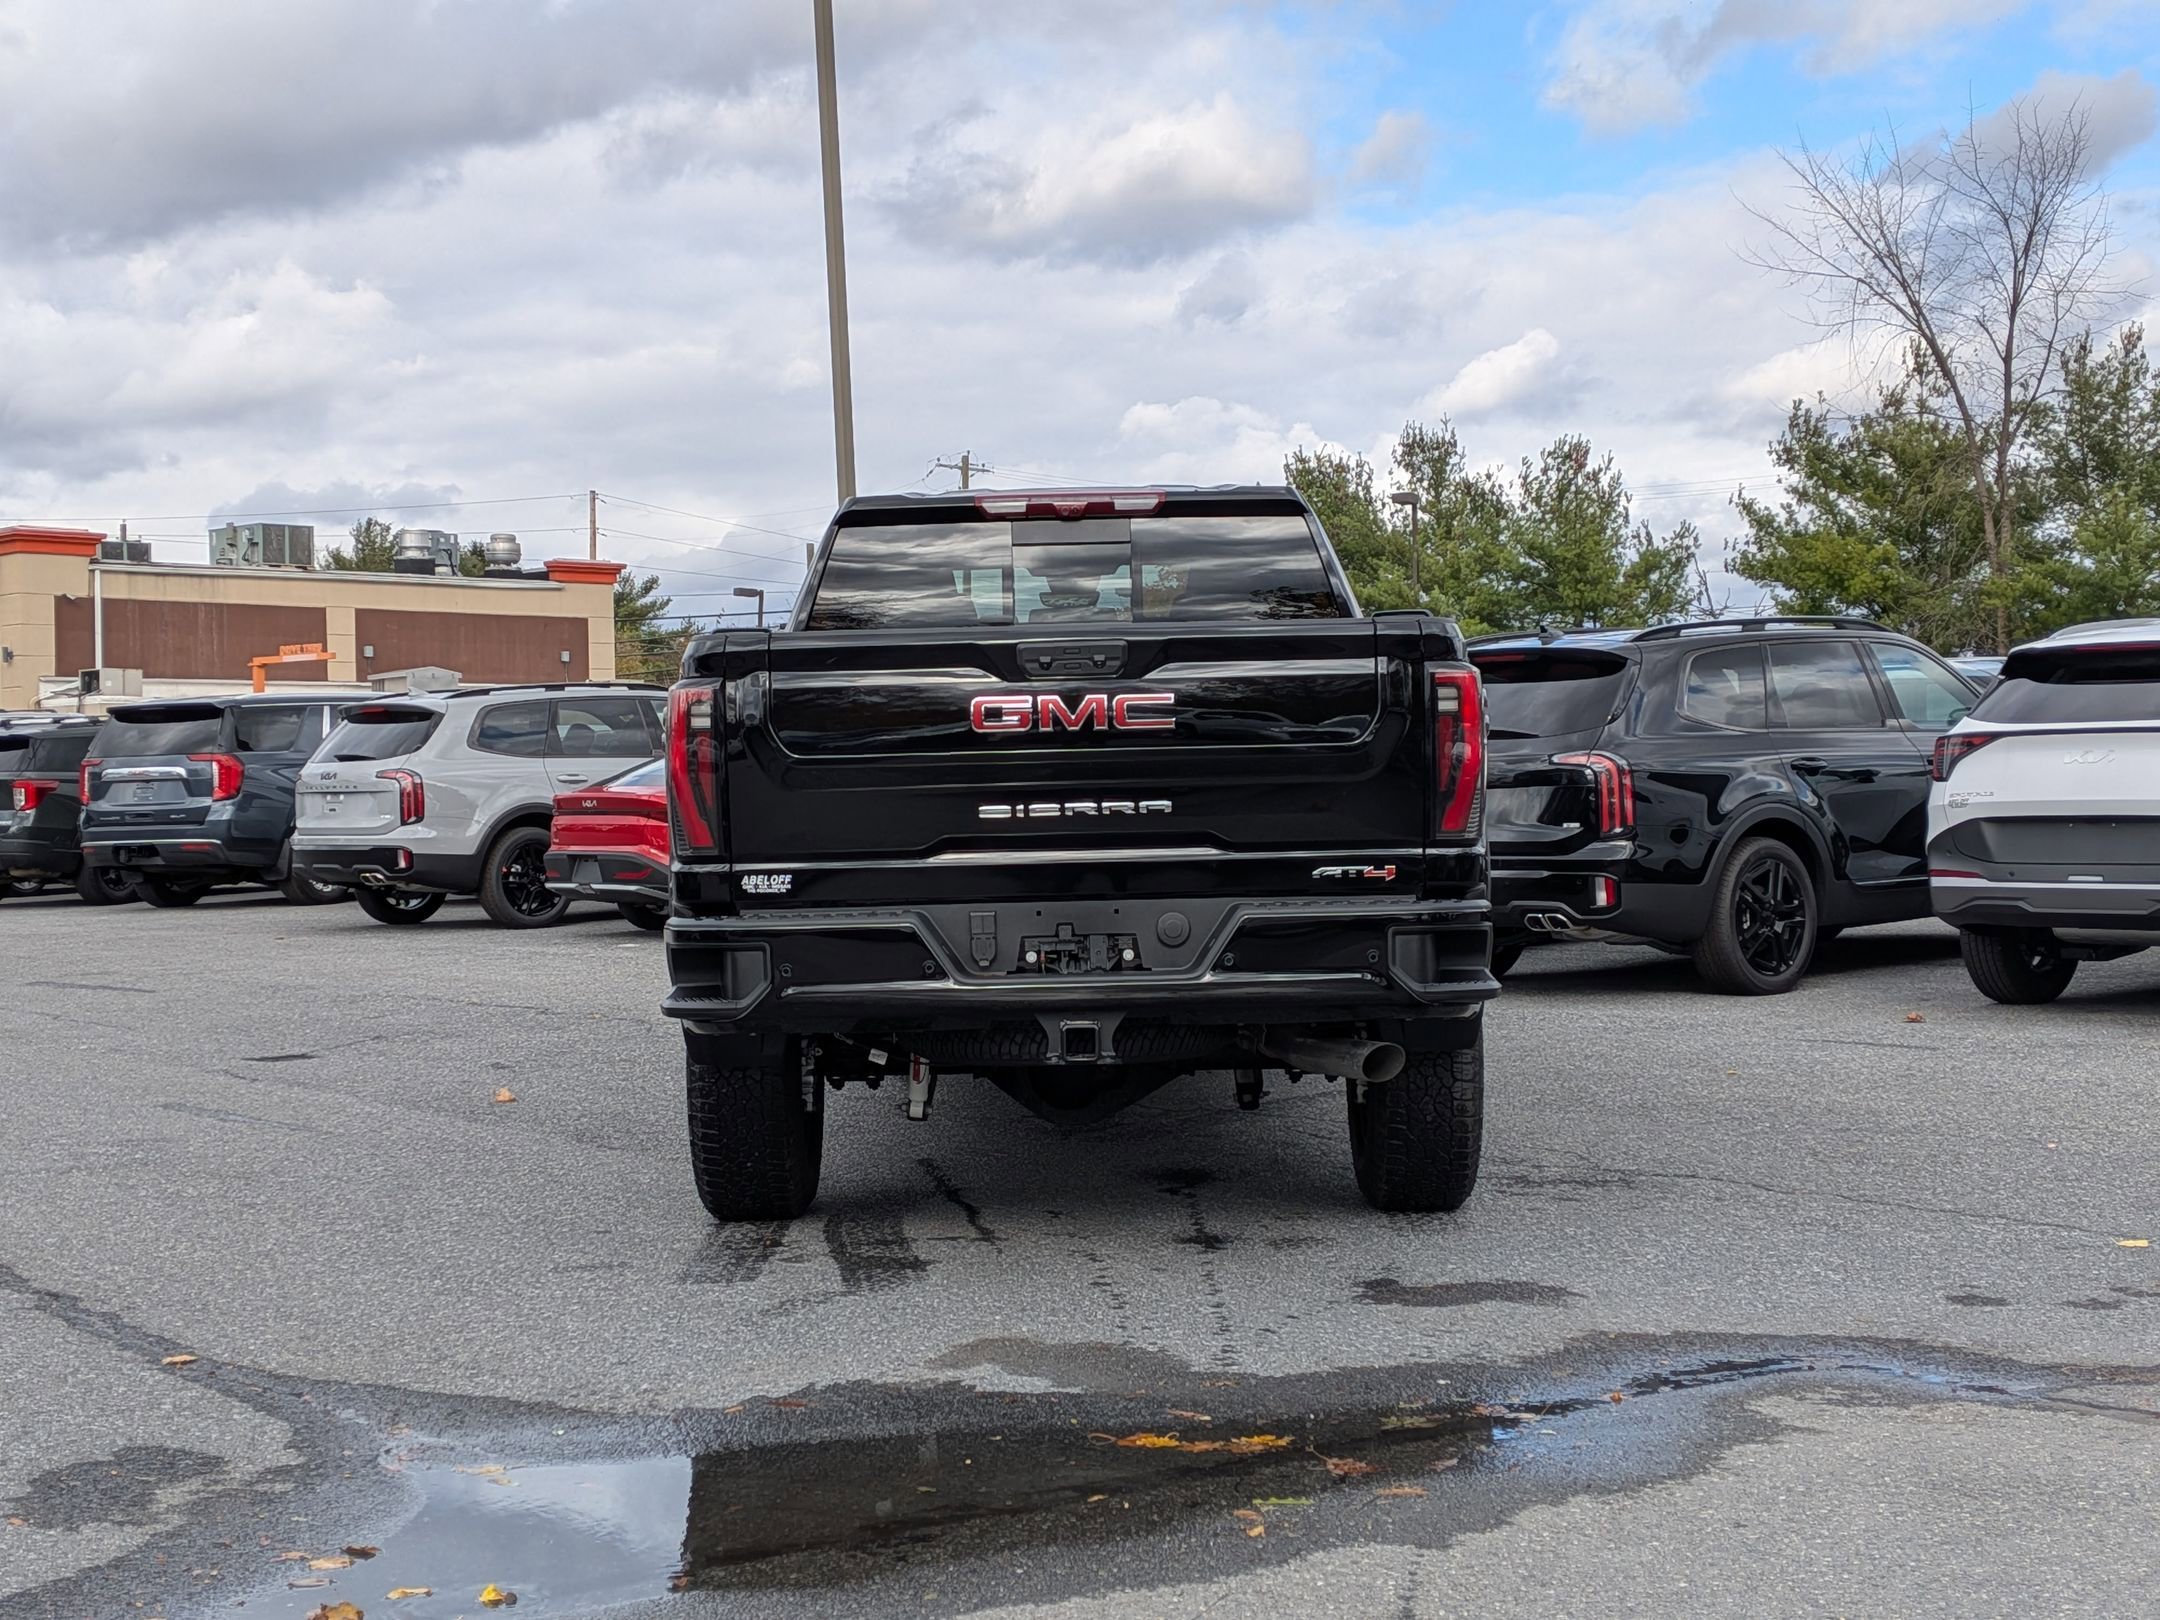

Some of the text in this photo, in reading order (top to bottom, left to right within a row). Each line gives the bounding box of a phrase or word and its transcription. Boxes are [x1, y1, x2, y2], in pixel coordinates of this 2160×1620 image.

[970, 693, 1176, 733] GMC
[320, 772, 337, 780] KIA
[581, 799, 598, 808] KIA
[978, 800, 1173, 819] SIERRA
[741, 874, 792, 885] ABELOFF
[1312, 865, 1396, 881] AT4
